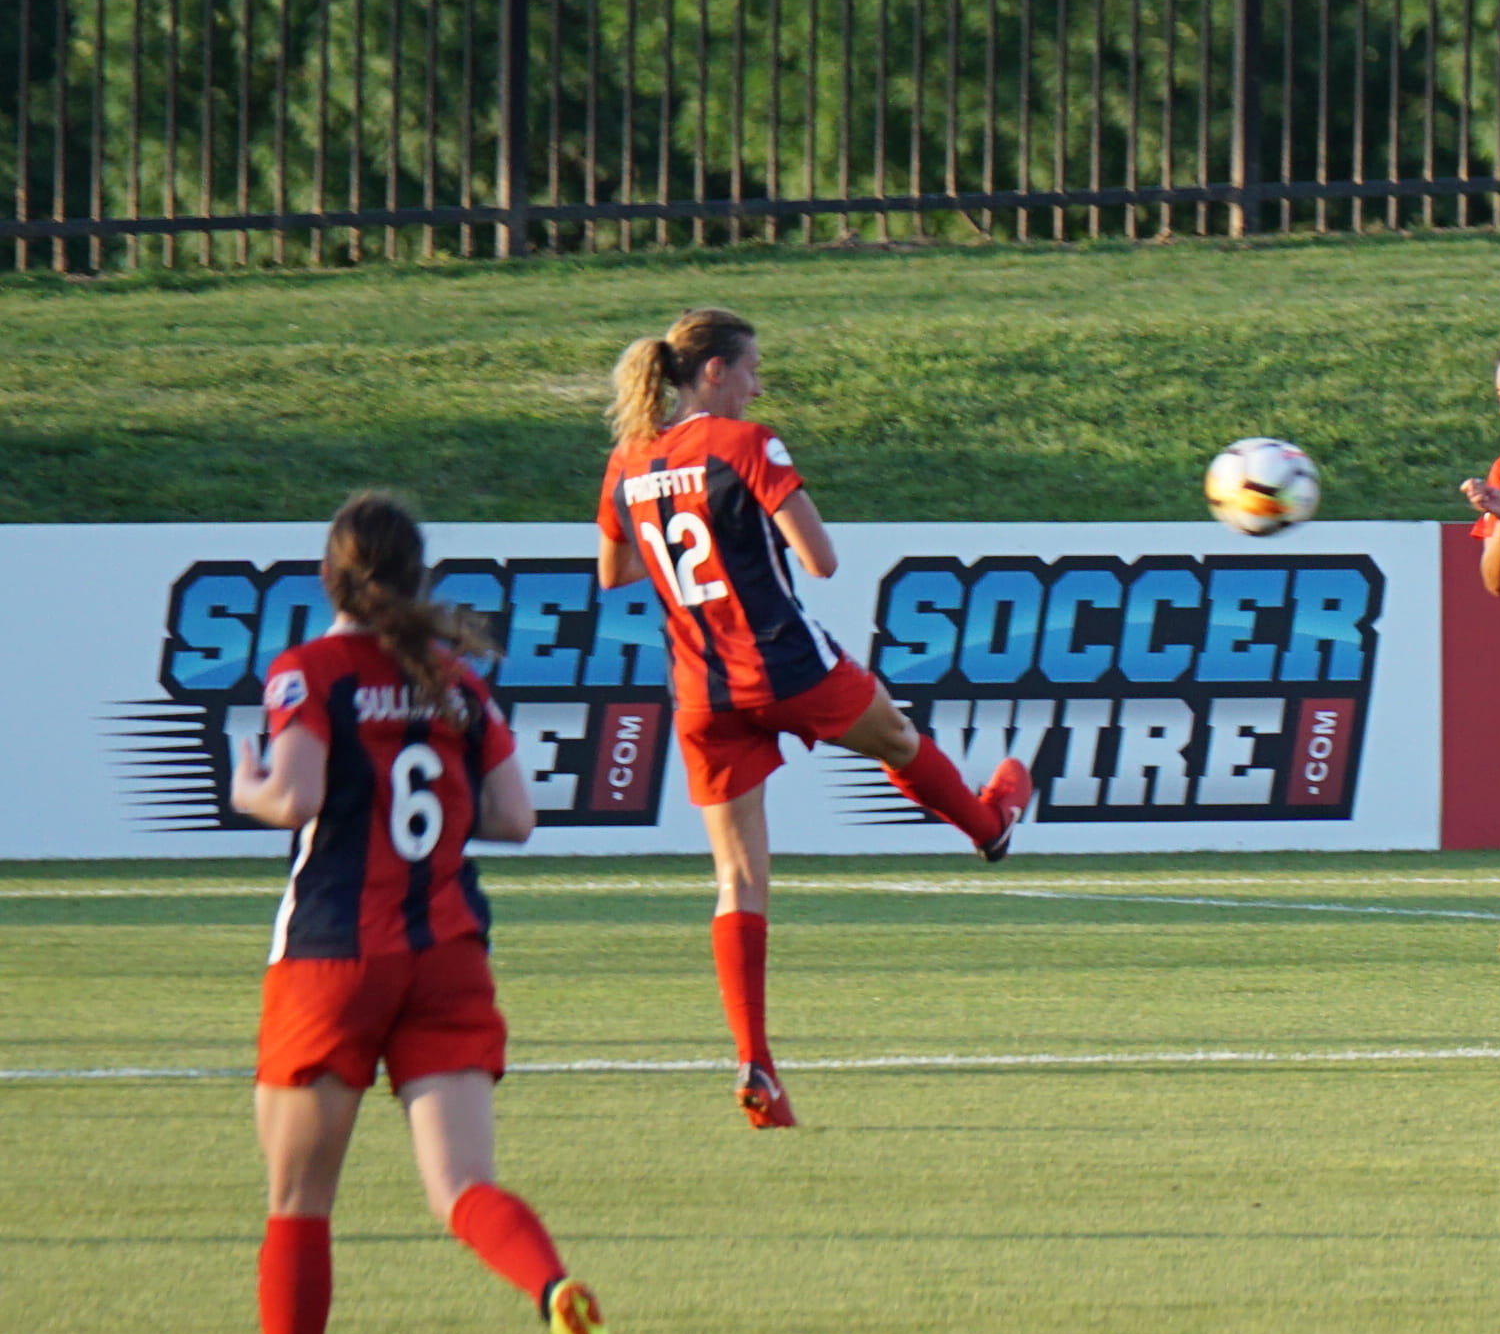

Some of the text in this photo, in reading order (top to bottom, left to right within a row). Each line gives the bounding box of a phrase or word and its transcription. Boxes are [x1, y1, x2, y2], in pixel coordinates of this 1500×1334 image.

[640, 512, 729, 607] 12
[170, 572, 669, 690] SOCER
[878, 569, 1371, 684] SOCCER
[389, 742, 444, 862] 6
[929, 697, 1286, 807] WIRE
